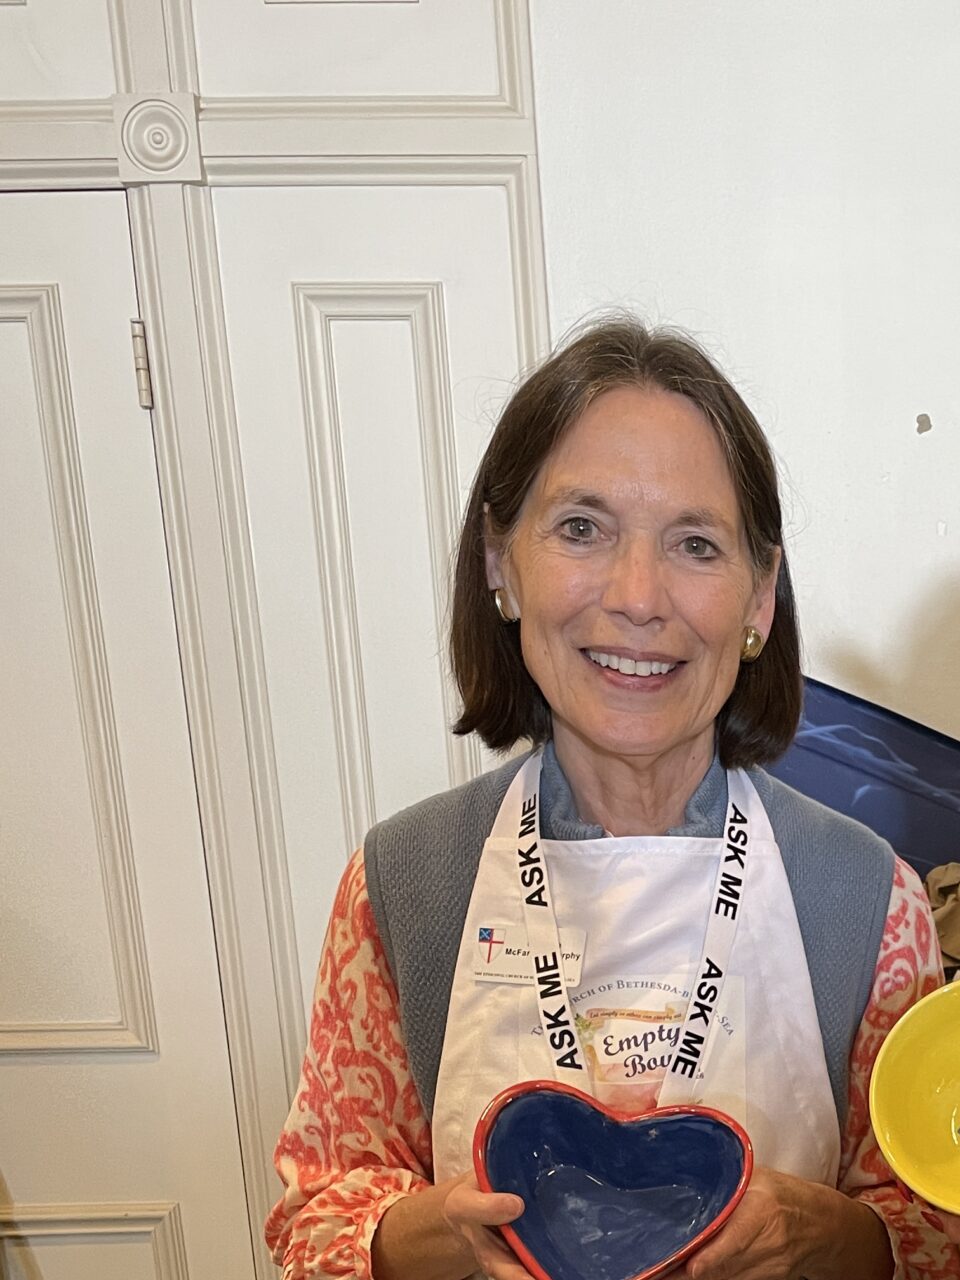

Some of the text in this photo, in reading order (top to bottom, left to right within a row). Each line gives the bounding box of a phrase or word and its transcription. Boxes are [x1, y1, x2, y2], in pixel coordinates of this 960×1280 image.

[518, 793, 548, 908] ASK ME
[714, 803, 748, 920] ASK ME
[534, 951, 584, 1070] ASK ME
[598, 983, 614, 993] OF
[603, 1024, 681, 1056] Empty
[671, 957, 723, 1079] ASK ME
